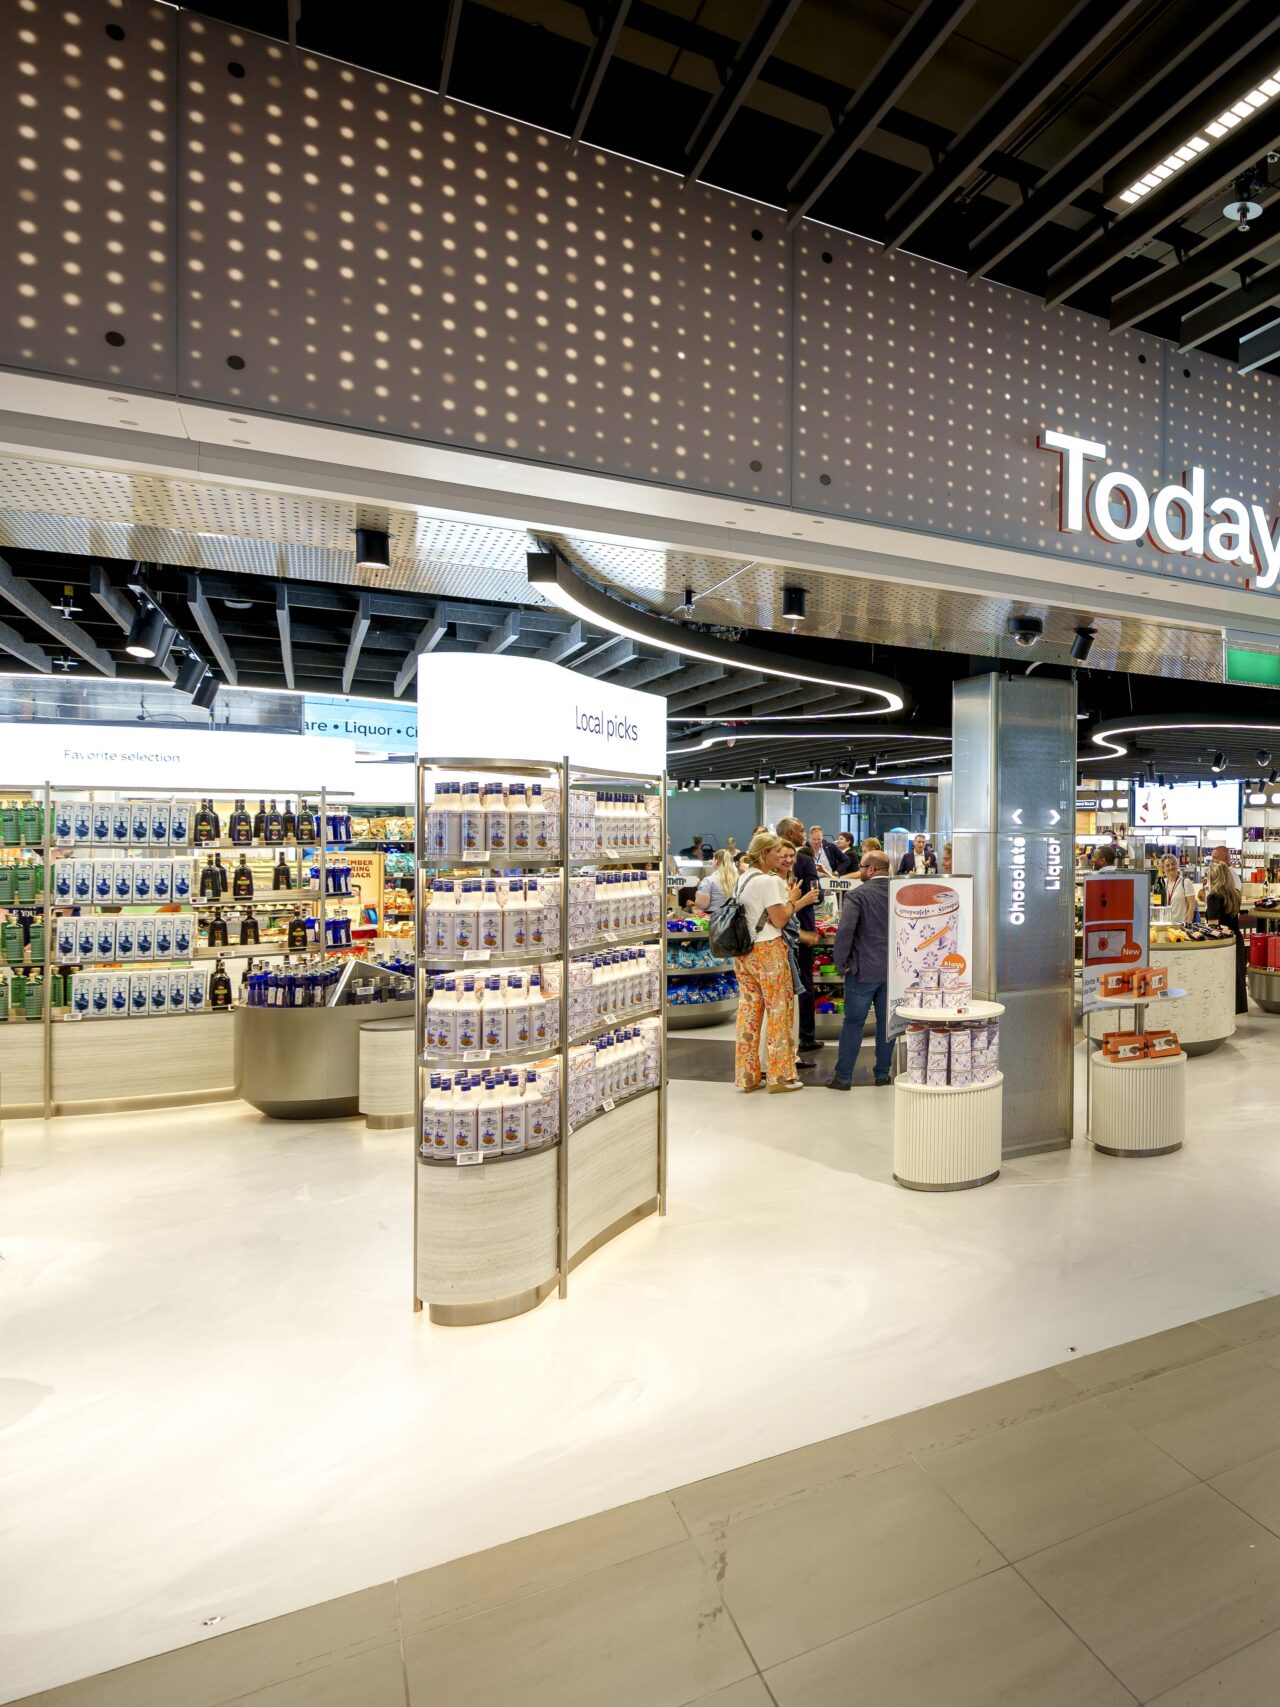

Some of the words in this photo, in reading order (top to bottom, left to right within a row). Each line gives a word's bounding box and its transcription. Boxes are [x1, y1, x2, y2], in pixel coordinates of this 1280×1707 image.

[344, 720, 393, 737] Liquor
[575, 704, 604, 735] Local
[606, 714, 638, 742] picks
[63, 749, 118, 761] Favorite
[121, 751, 181, 764] selection
[1044, 836, 1064, 890] Liquor
[1008, 836, 1026, 925] Chocolate
[1122, 948, 1140, 956] New
